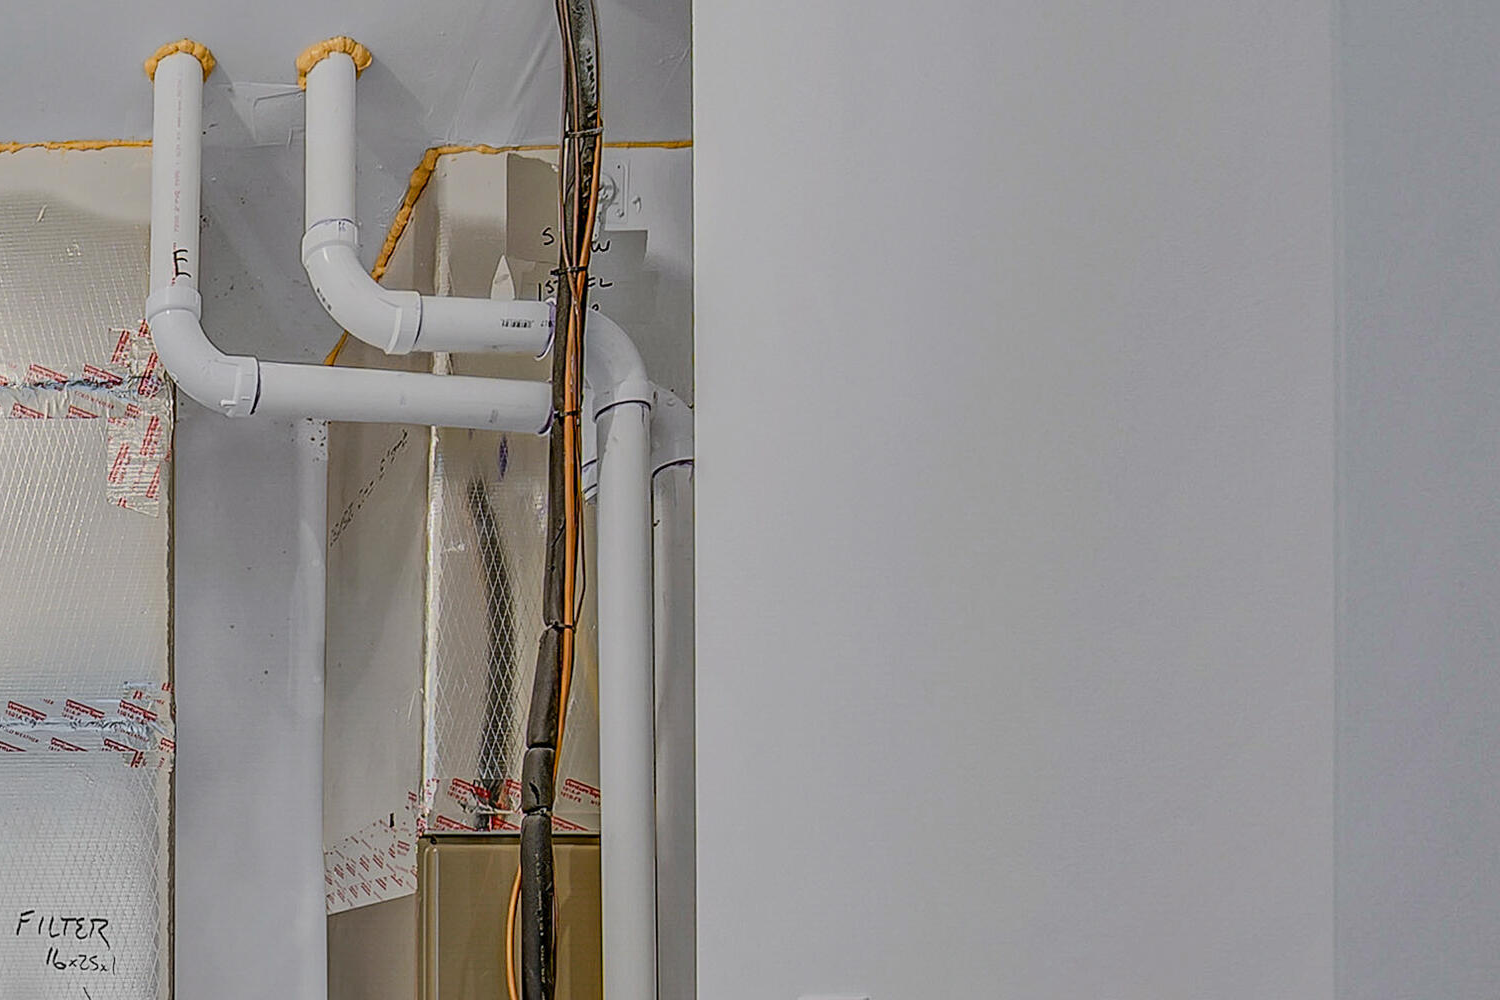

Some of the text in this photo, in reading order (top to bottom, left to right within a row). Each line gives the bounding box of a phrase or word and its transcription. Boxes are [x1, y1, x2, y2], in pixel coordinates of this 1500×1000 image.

[173, 249, 192, 279] E
[16, 910, 111, 950] FILTER
[46, 946, 116, 976] 16x25x1
